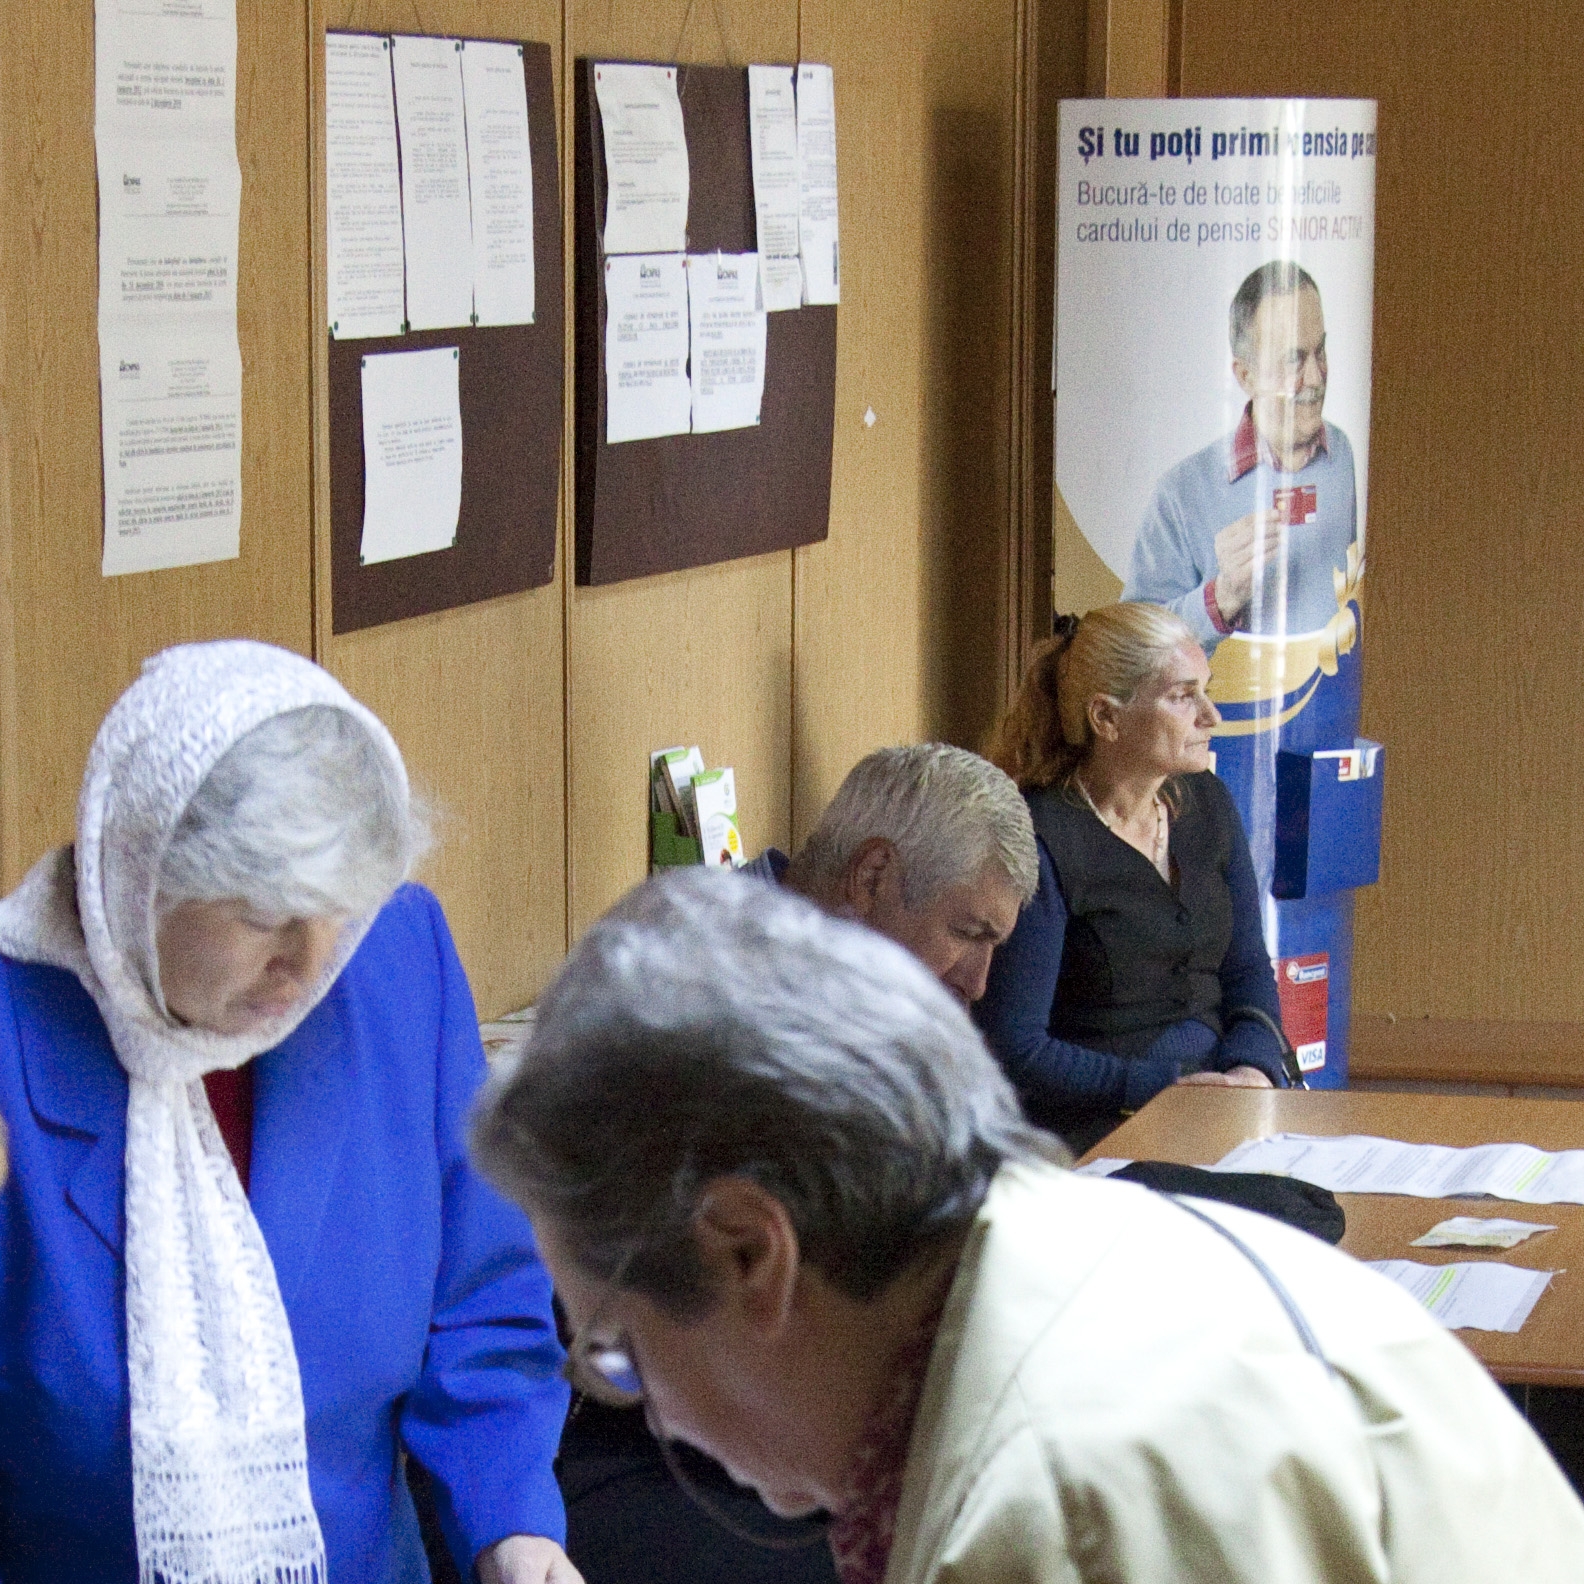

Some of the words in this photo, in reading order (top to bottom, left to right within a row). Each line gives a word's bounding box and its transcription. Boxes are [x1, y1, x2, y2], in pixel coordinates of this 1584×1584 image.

[1078, 127, 1104, 165] Și
[1114, 128, 1139, 157] tu
[1151, 127, 1201, 164] poți
[1212, 127, 1279, 160] primi
[1287, 128, 1347, 158] ensia
[1078, 179, 1176, 206] Bucură-te
[1183, 180, 1207, 205] de
[1214, 182, 1260, 206] toate
[1077, 219, 1158, 243] cardului
[1167, 219, 1190, 243] de
[1197, 219, 1261, 246] pensie
[1267, 216, 1327, 241] SNIOR
[1301, 1048, 1324, 1065] VISA
